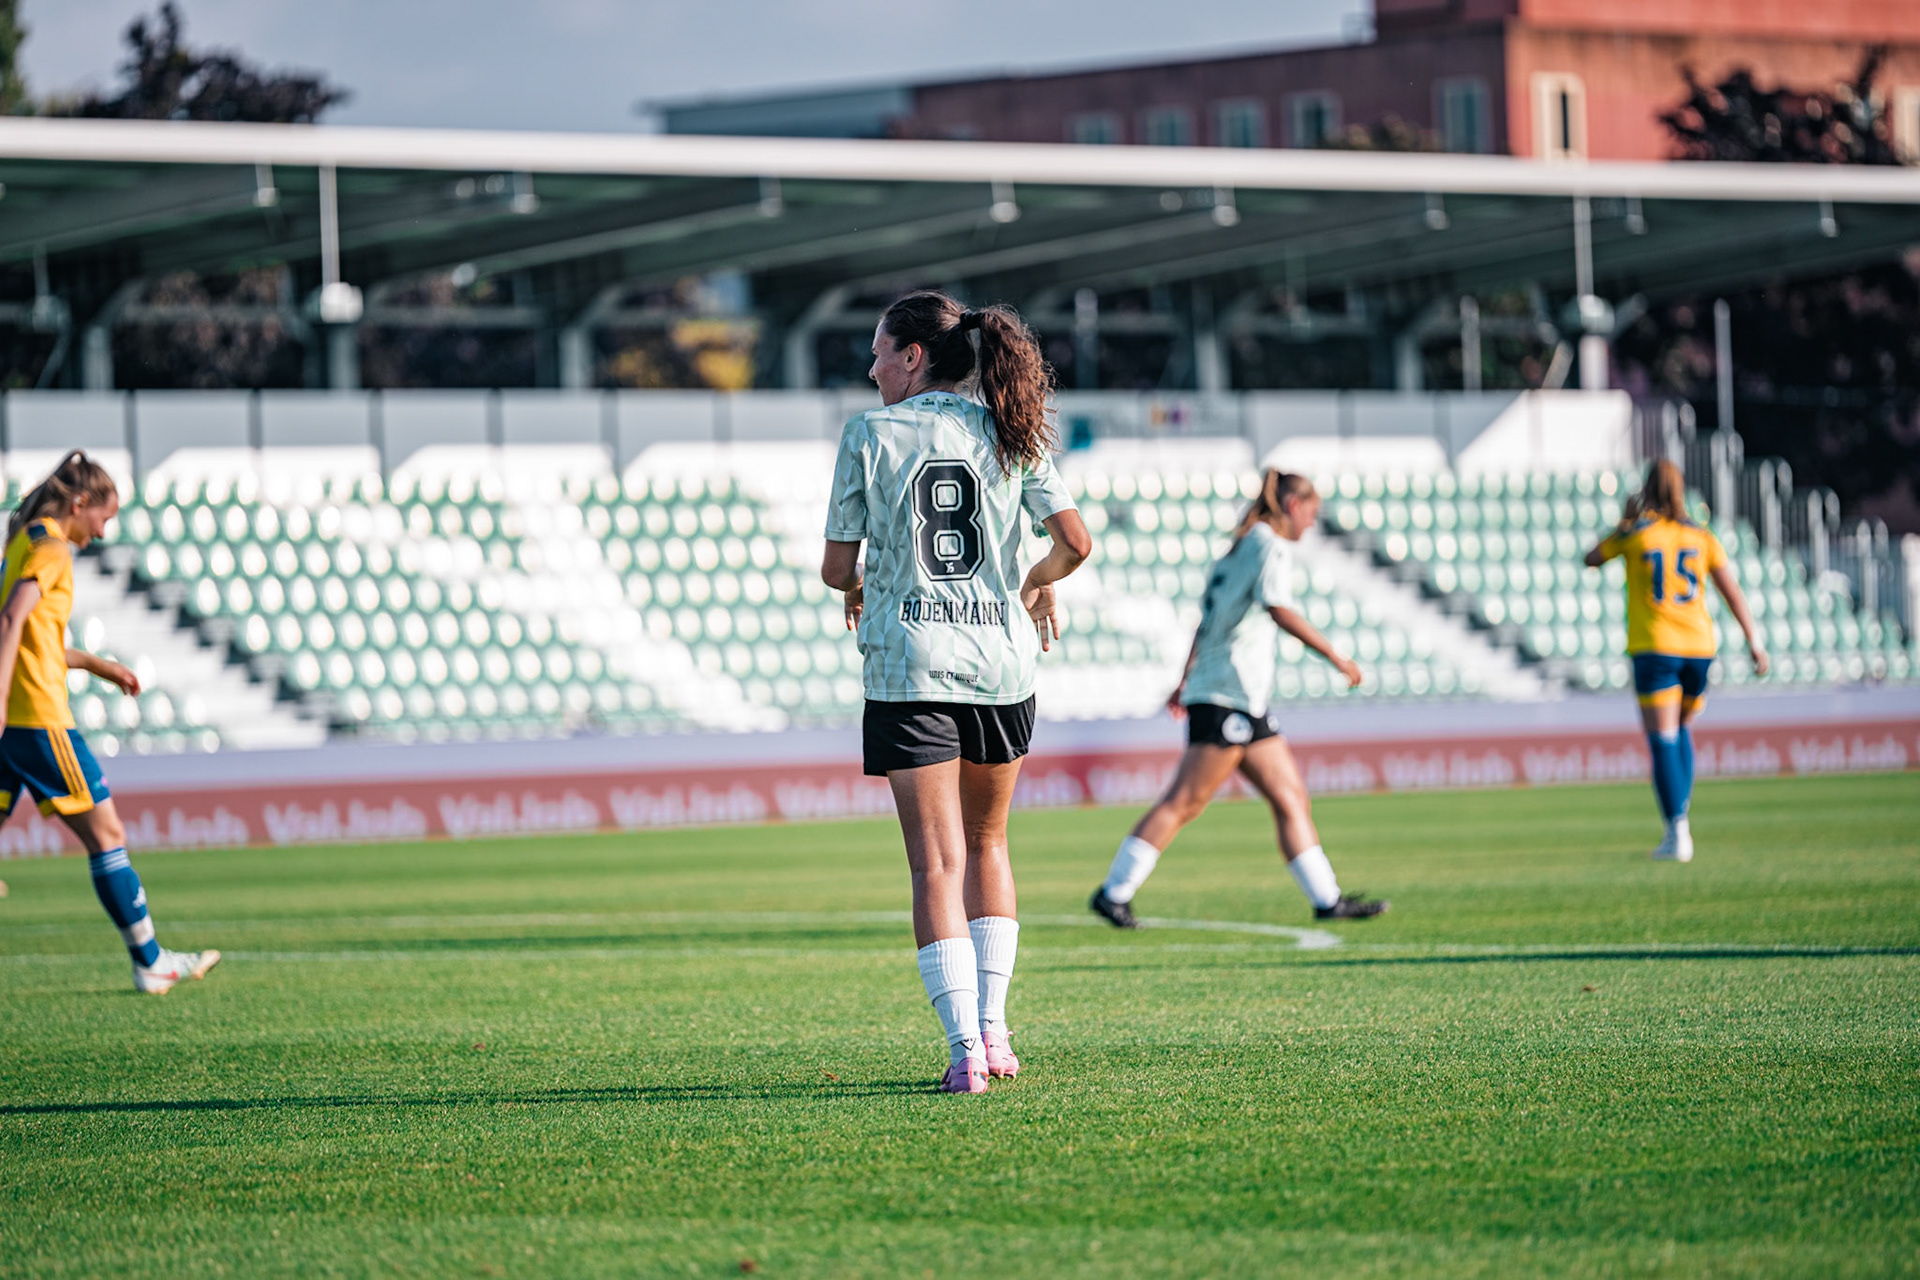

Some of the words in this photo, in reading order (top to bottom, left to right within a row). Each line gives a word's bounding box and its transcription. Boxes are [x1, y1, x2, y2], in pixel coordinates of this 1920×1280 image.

[912, 459, 985, 582] 8
[1643, 549, 1698, 604] 15
[900, 600, 1005, 626] BODENMANN
